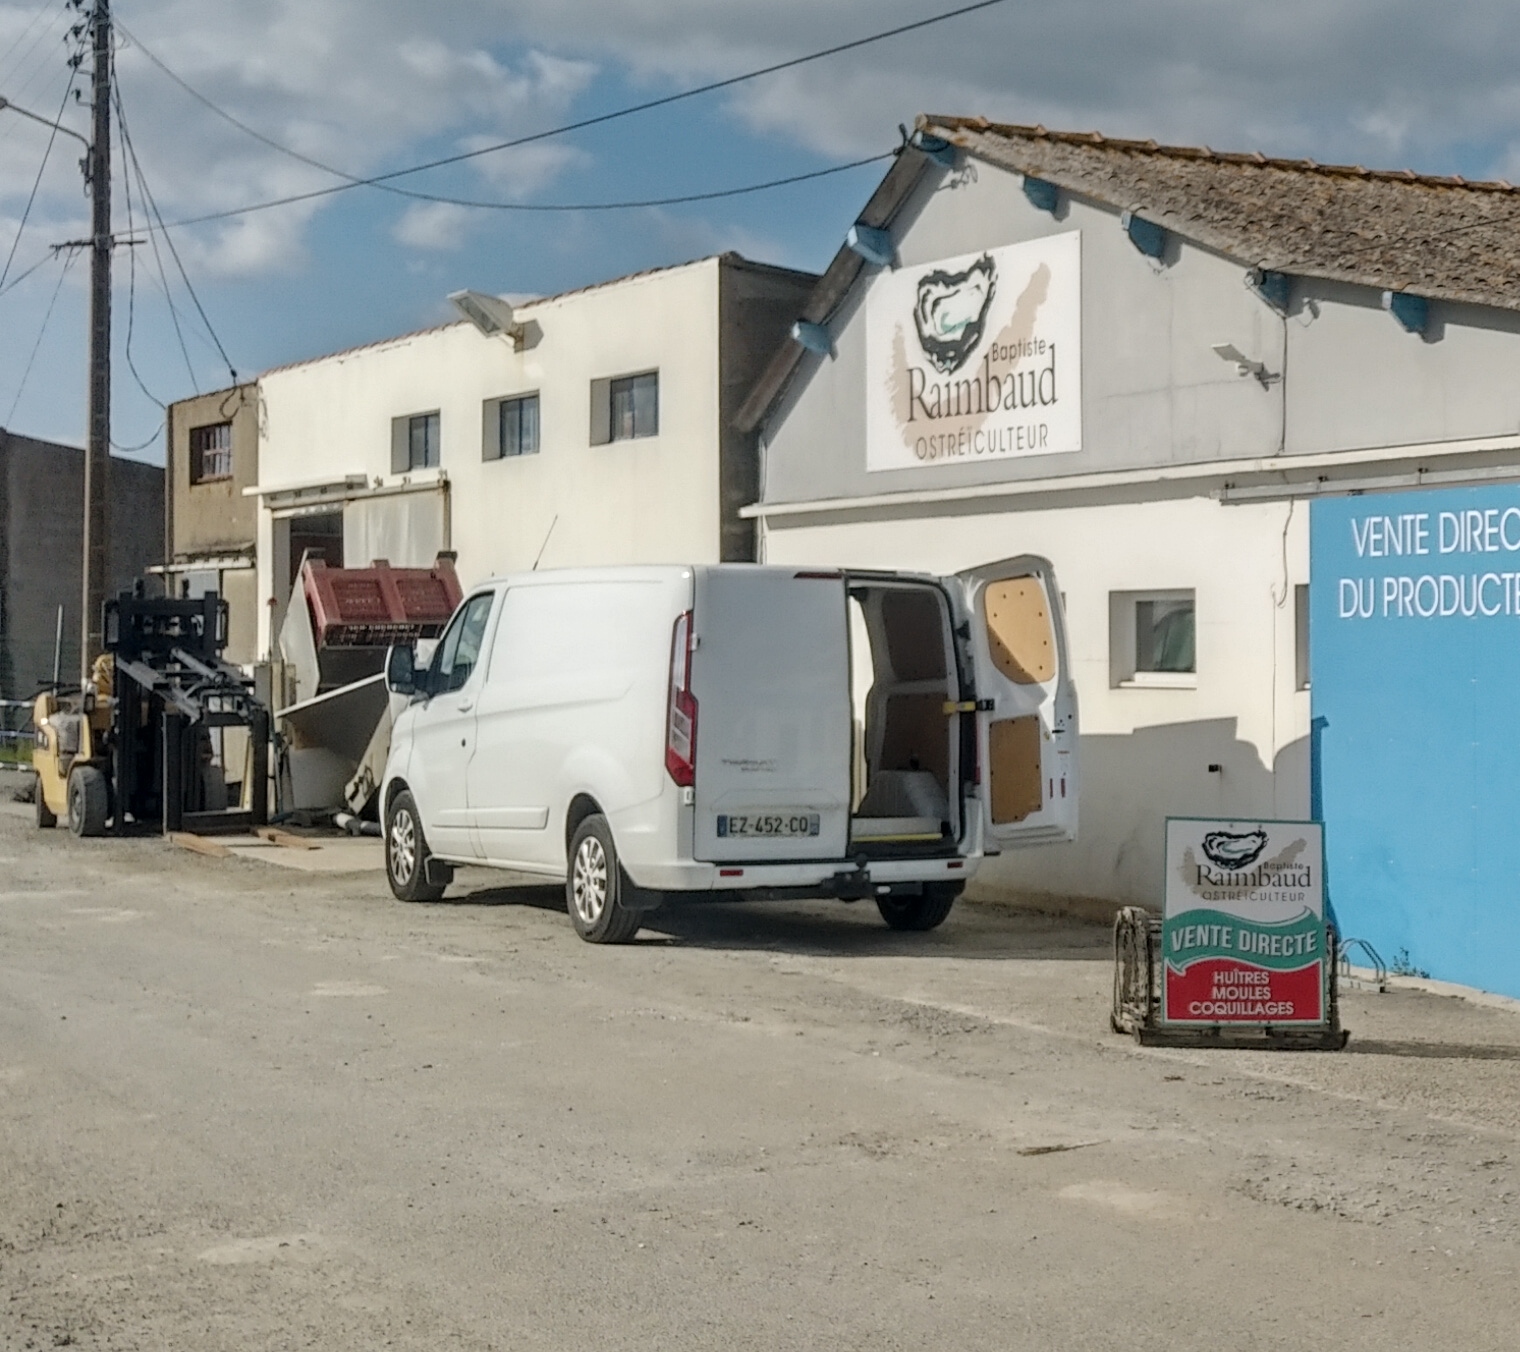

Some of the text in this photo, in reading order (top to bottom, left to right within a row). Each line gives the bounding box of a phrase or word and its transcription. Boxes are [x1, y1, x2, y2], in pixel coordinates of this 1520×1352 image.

[991, 335, 1047, 364] Baptiste
[906, 342, 1059, 423] Raimbaud
[1351, 513, 1430, 558] VENTE
[1339, 577, 1375, 619] DU
[1196, 864, 1312, 888] Raimbaud
[1263, 861, 1304, 872] Baptiste
[1171, 924, 1318, 957] VENTE DIRECTE
[1213, 967, 1270, 985] HUÎTRES
[1212, 986, 1271, 1000] MOULES
[1189, 1001, 1295, 1016] COQUILLAGES
